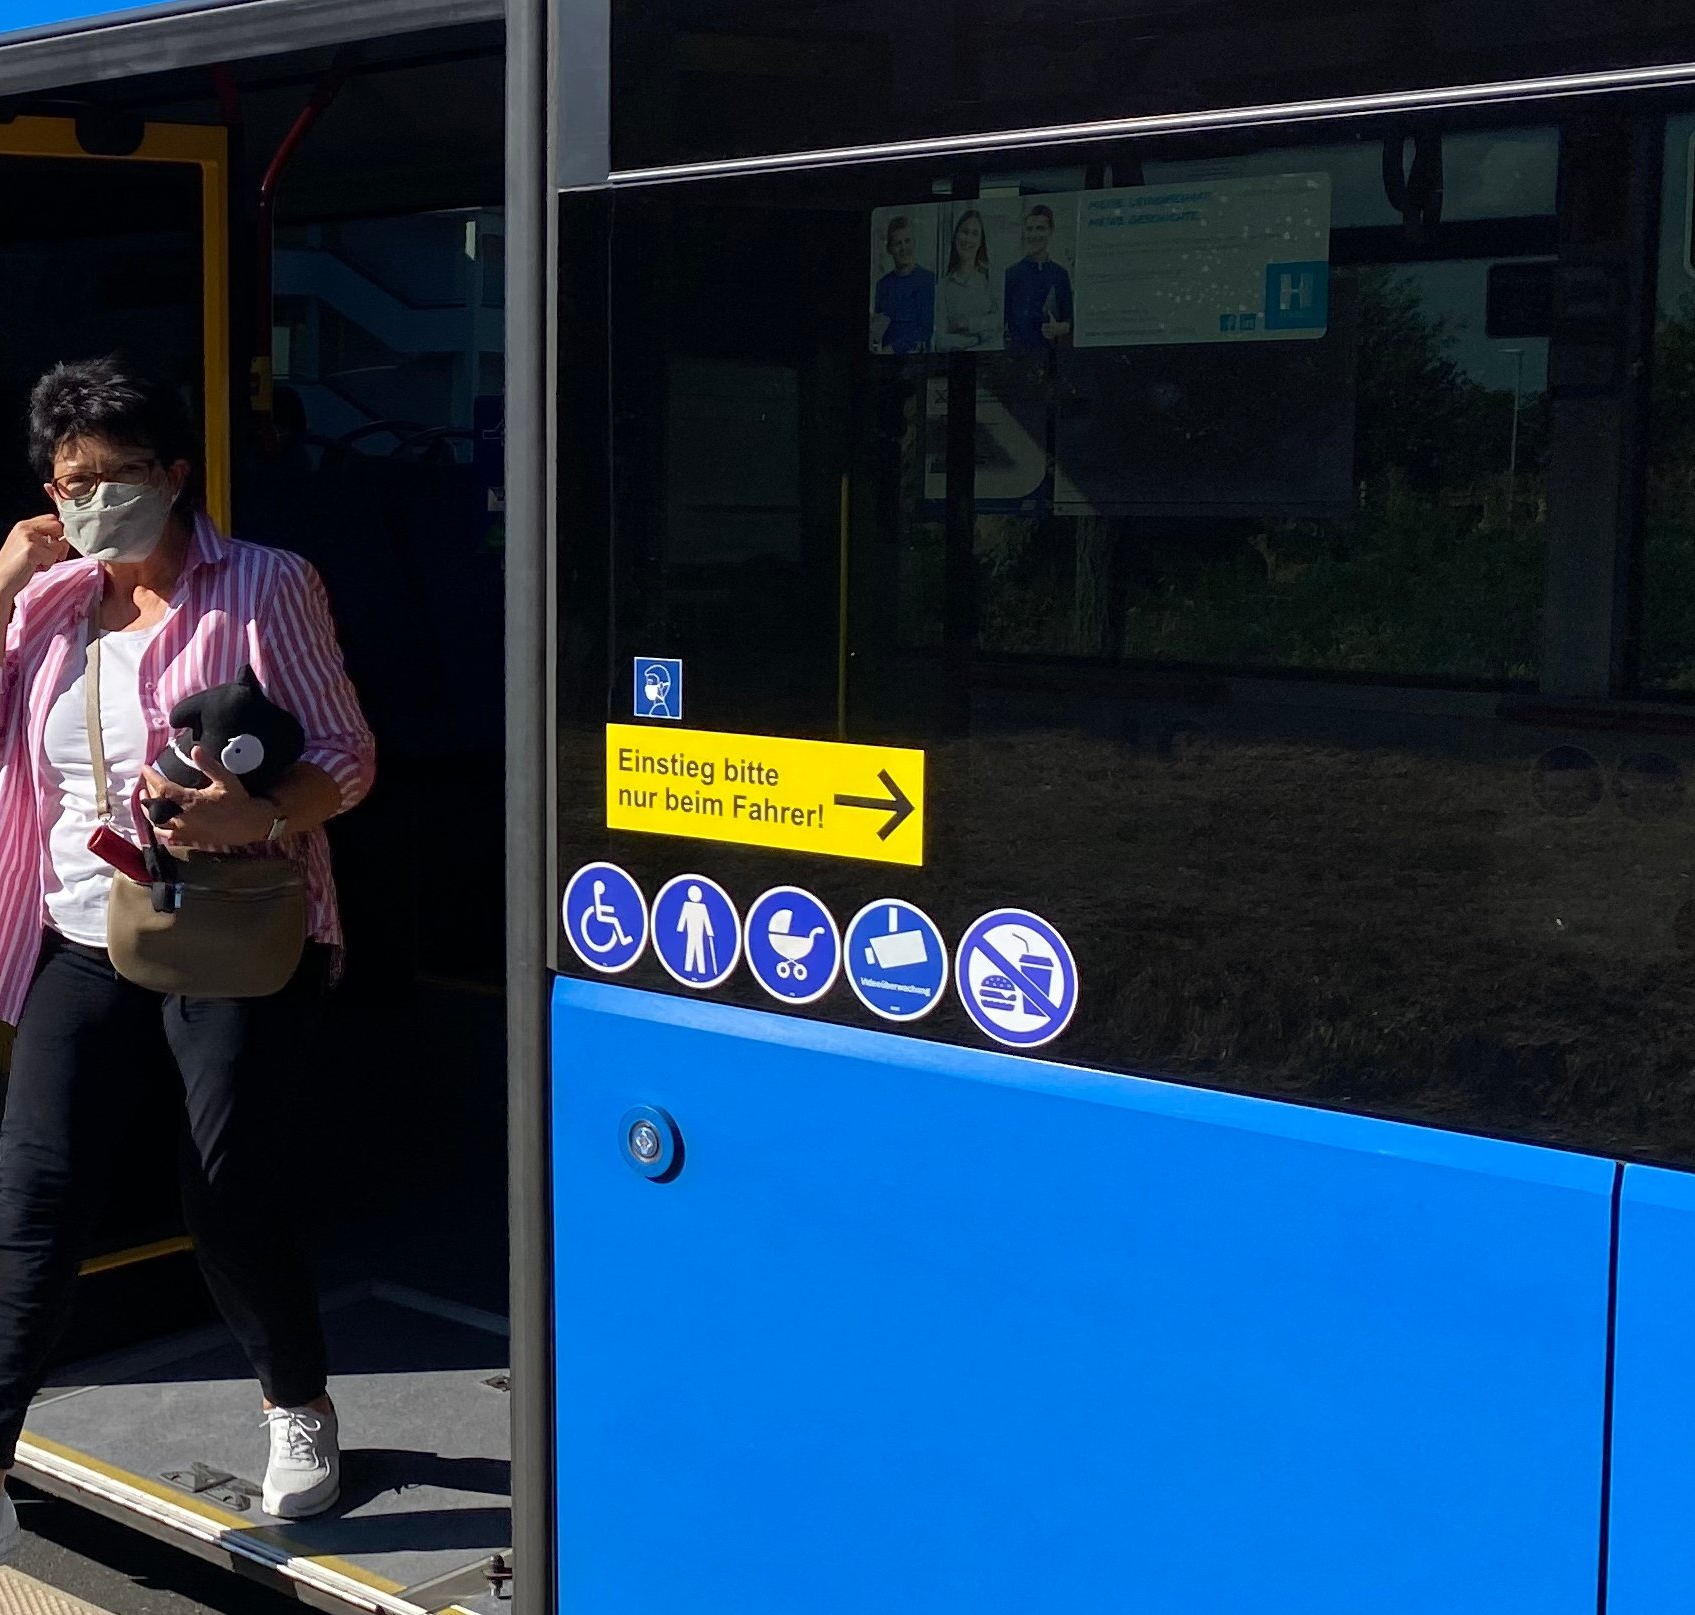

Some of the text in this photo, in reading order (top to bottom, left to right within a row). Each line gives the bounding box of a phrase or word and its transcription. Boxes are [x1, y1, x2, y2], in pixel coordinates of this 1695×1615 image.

[618, 747, 779, 787] Einstieg bitte
[618, 786, 824, 829] nur beim Fahrer!
